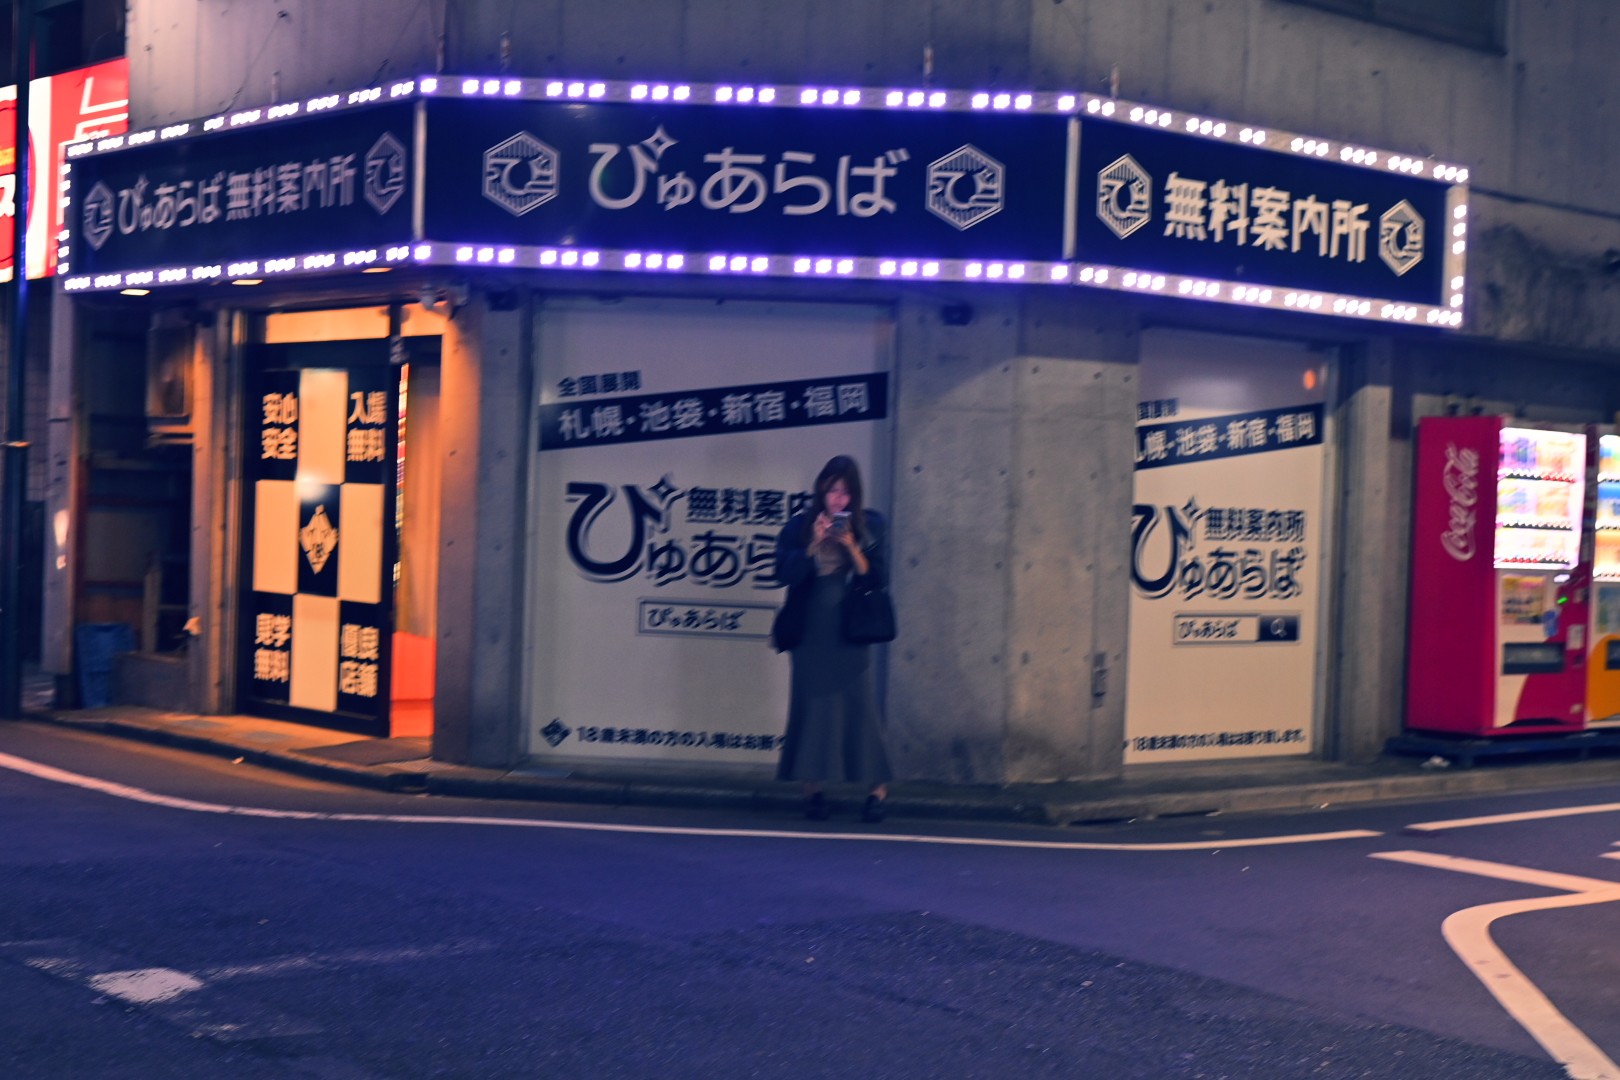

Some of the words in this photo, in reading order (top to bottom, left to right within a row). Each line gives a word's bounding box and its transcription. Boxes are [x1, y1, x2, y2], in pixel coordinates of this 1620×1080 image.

[118, 153, 357, 236] ぴゅあらば無料案内所
[588, 125, 910, 217] ぴゅあらば
[1163, 171, 1370, 263] 無料案内所
[348, 391, 388, 425] 入場
